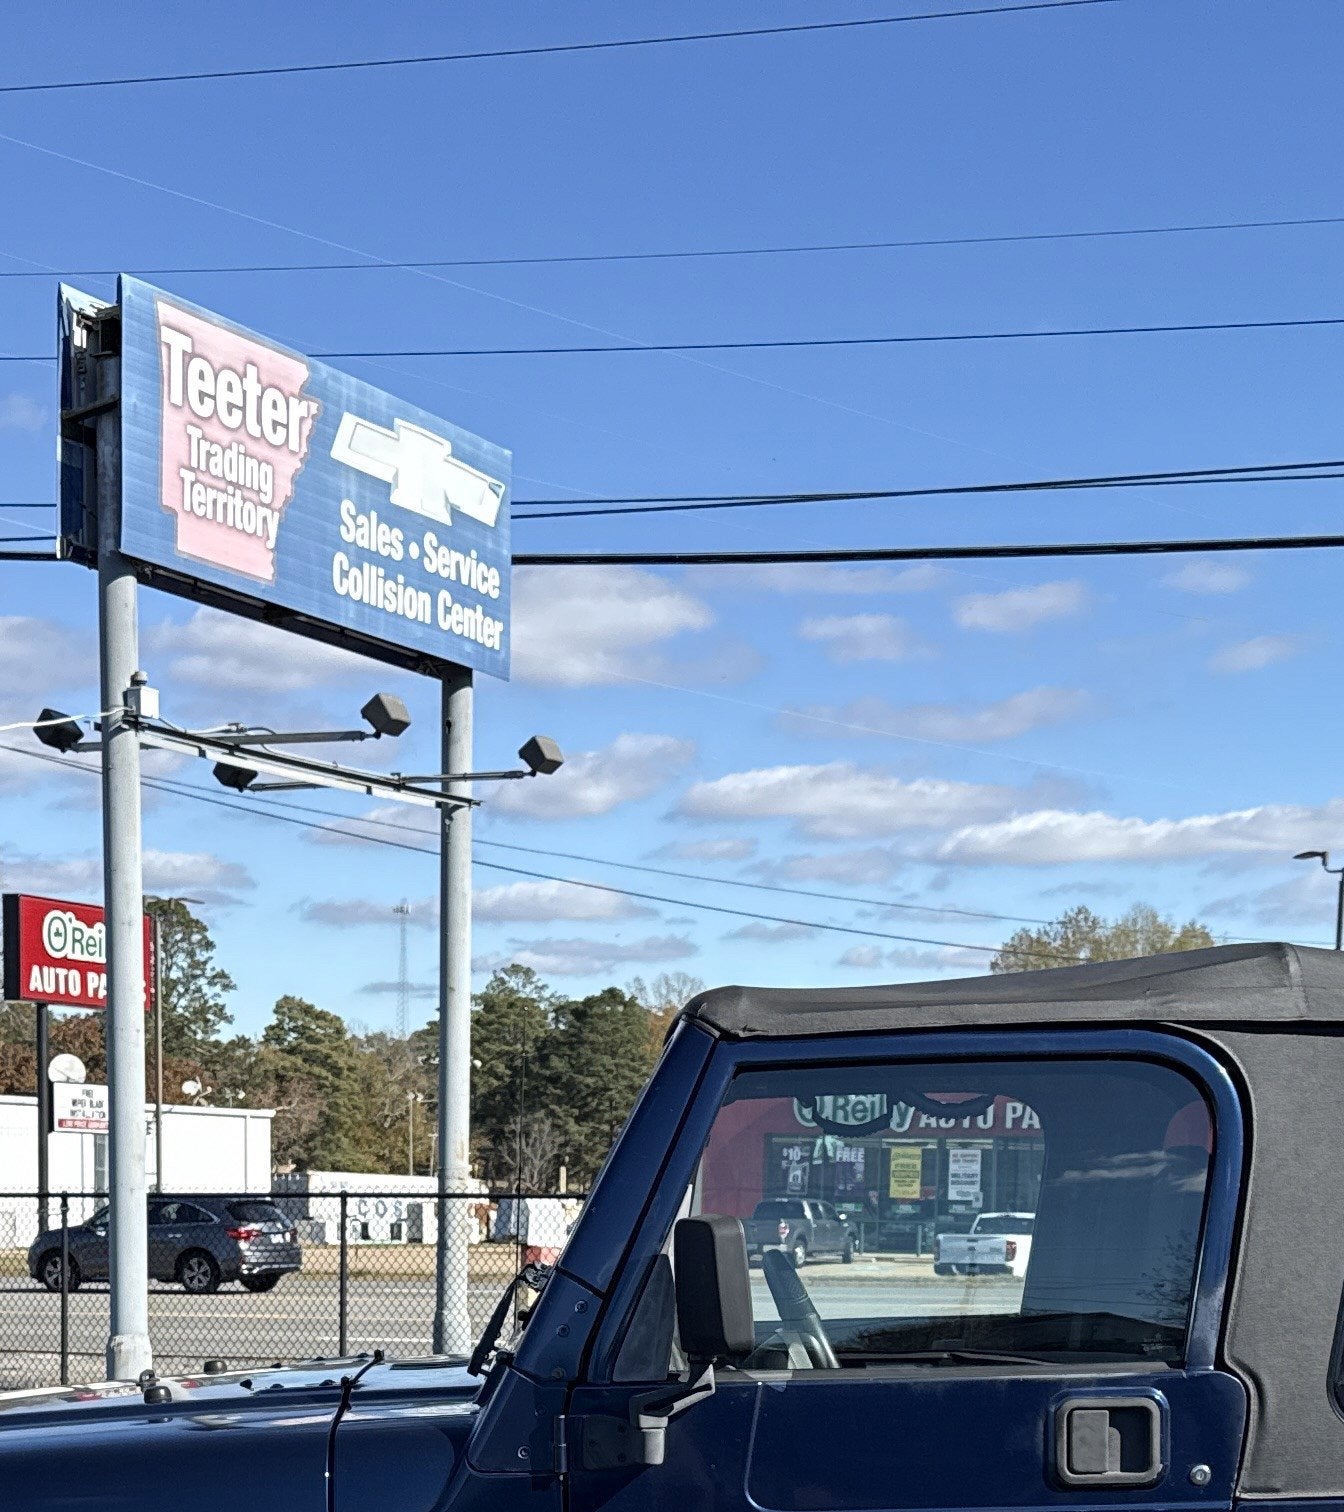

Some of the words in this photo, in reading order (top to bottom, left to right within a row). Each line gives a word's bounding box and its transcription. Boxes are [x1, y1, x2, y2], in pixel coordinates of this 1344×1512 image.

[160, 326, 308, 452] Teeter
[186, 425, 274, 499] Trading
[179, 469, 280, 550] Territory
[340, 499, 404, 561] Sales
[423, 532, 501, 600] Service
[332, 552, 432, 624] Collision
[437, 591, 504, 651] Center
[47, 915, 106, 958] O'Rei
[29, 964, 82, 998] AUTO
[835, 1147, 865, 1162] FREE
